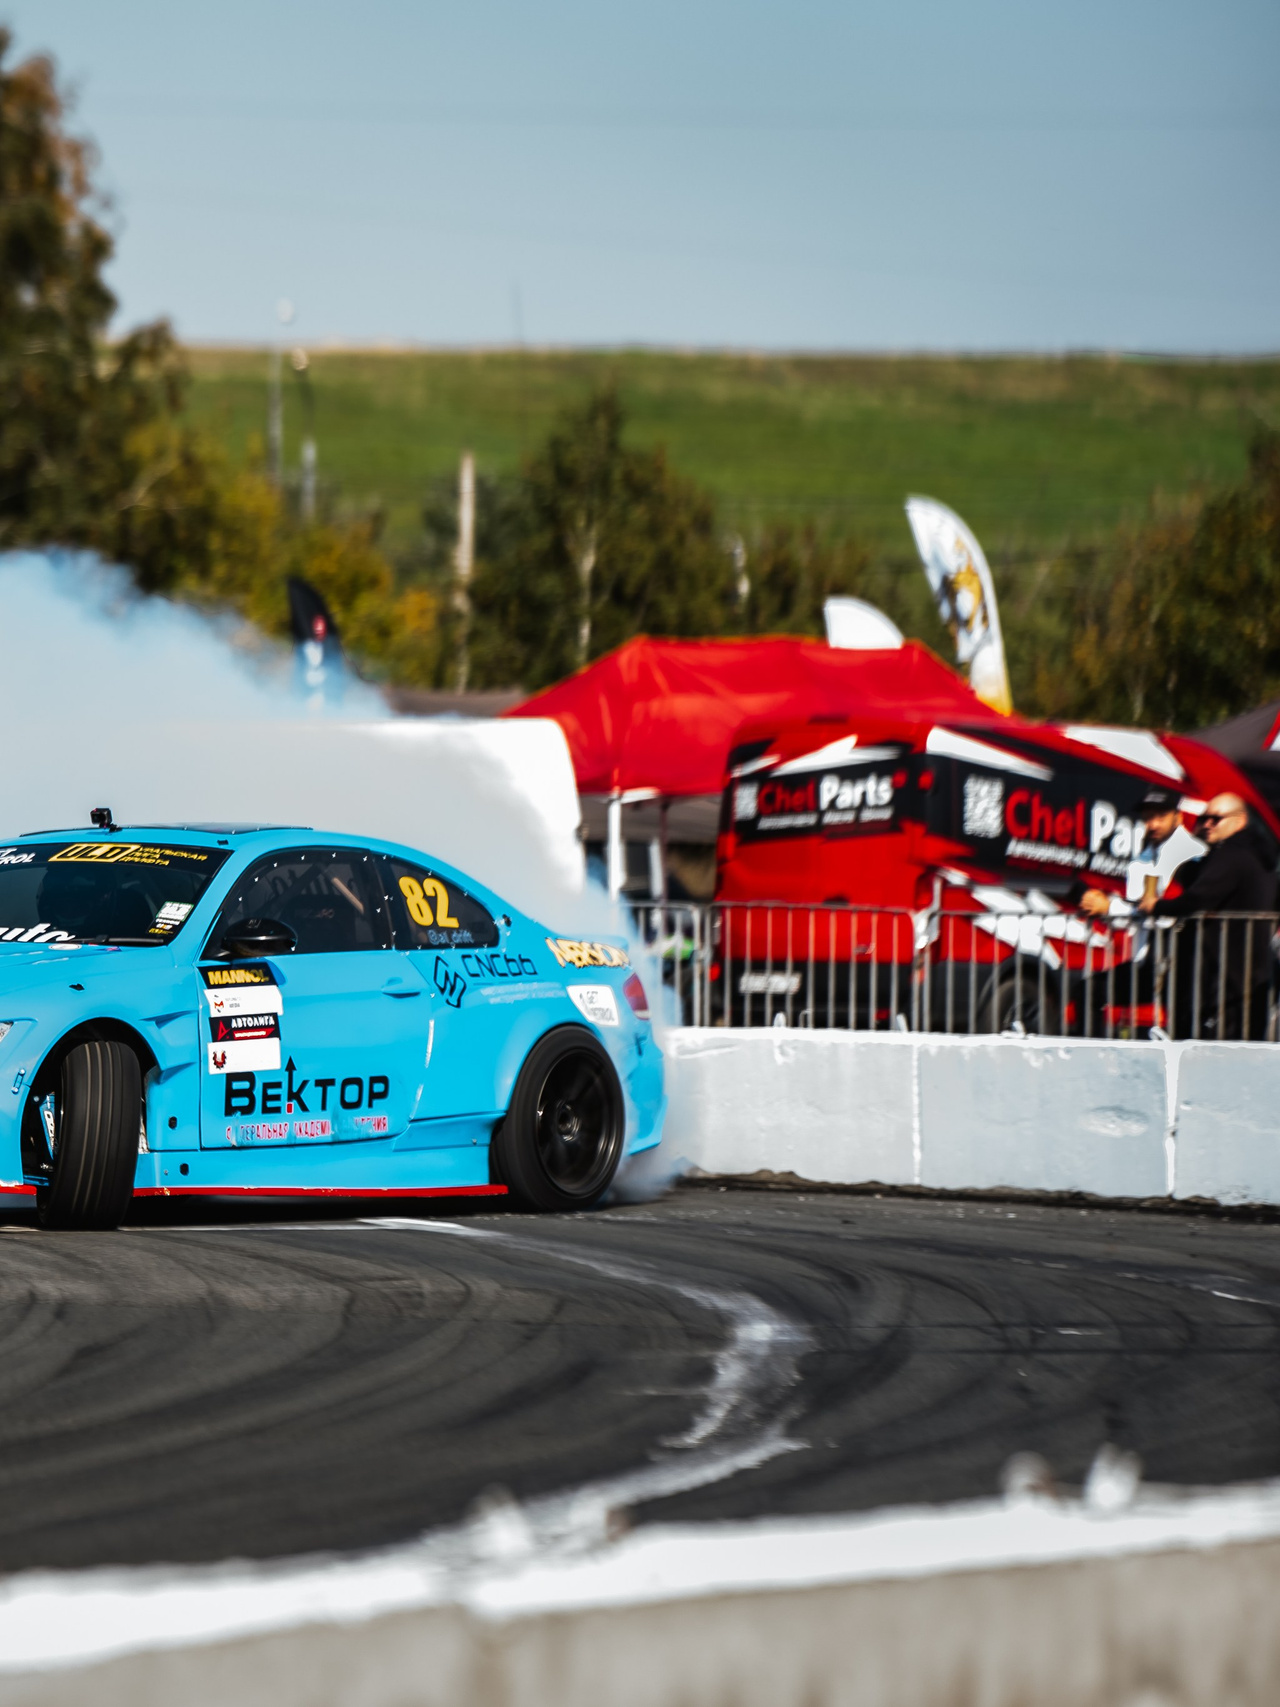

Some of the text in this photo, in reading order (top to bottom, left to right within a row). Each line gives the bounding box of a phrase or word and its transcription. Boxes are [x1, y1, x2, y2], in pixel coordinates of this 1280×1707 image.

[398, 876, 459, 928] 82
[207, 969, 270, 985] MANNOL
[231, 1016, 275, 1028] АВТОЛИГА
[225, 1064, 389, 1117] ВЕКТОР
